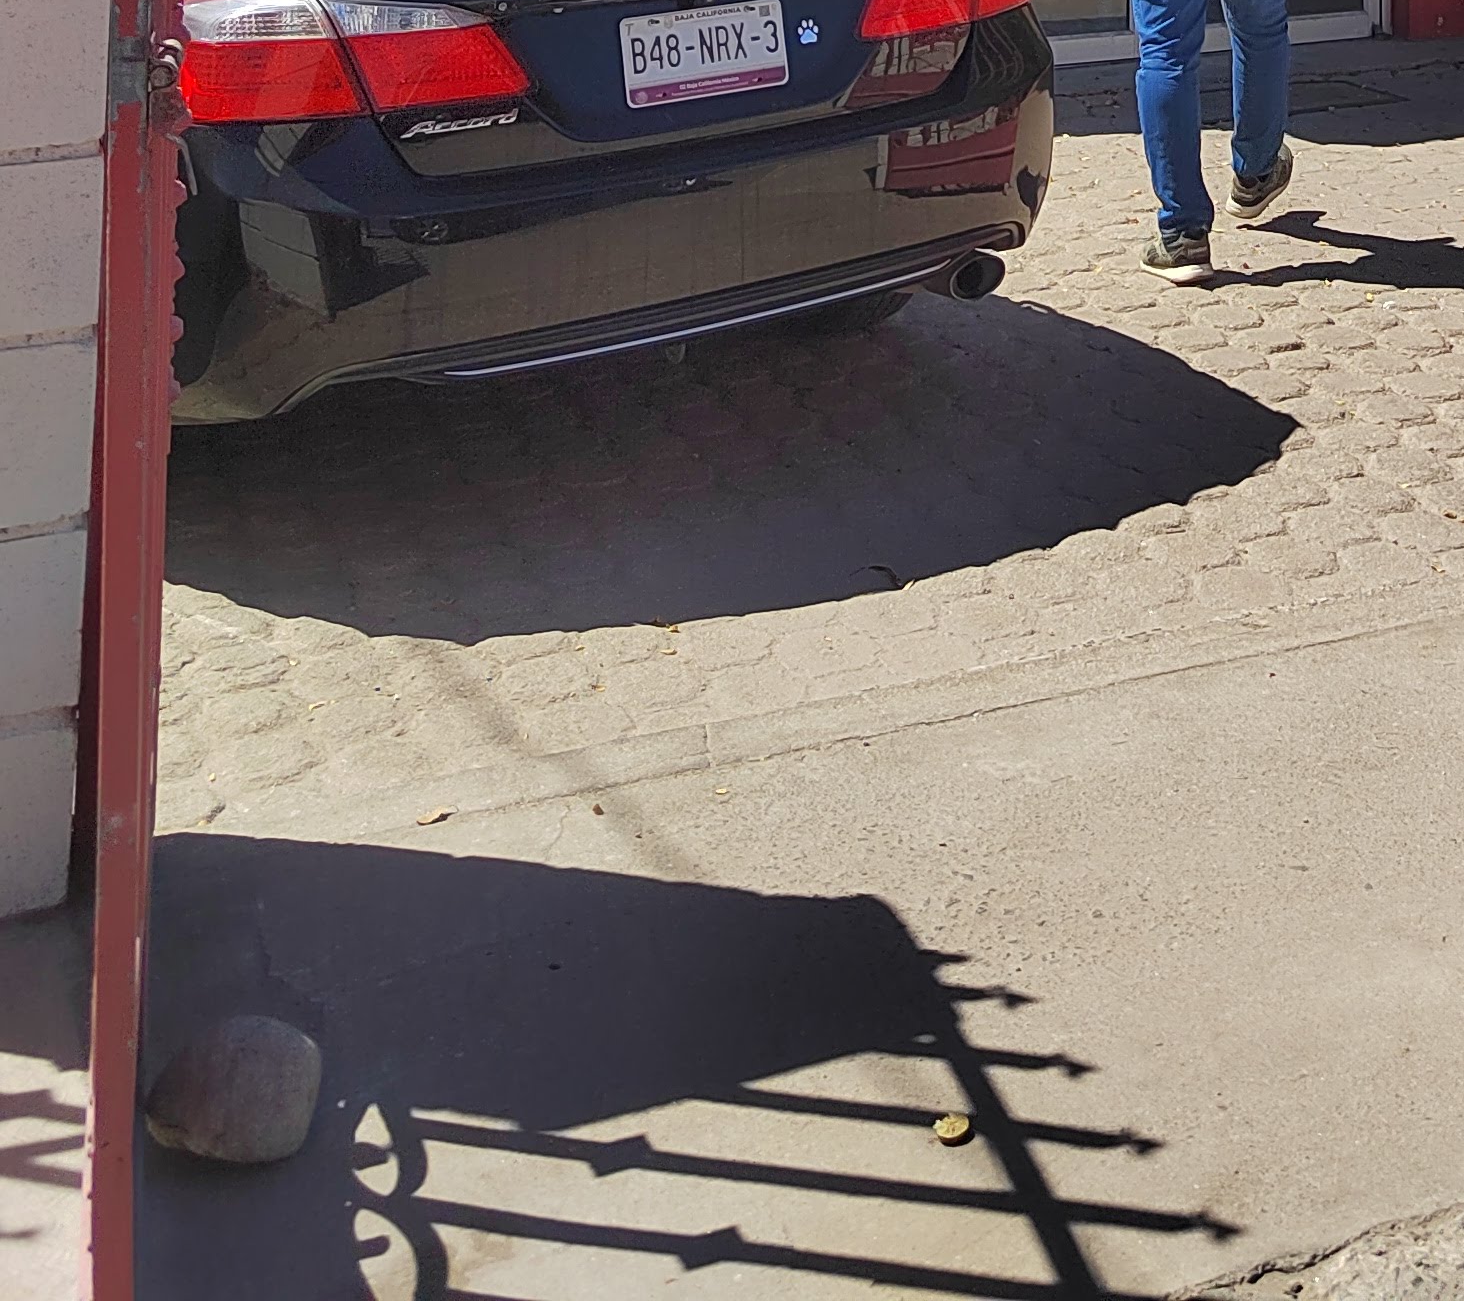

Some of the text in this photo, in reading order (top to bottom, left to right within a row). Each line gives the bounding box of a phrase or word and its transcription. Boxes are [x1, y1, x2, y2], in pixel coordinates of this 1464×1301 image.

[674, 7, 742, 22] BAJA CALIFORNIA
[630, 19, 779, 75] B48-NRX-3
[400, 108, 519, 138] Accord
